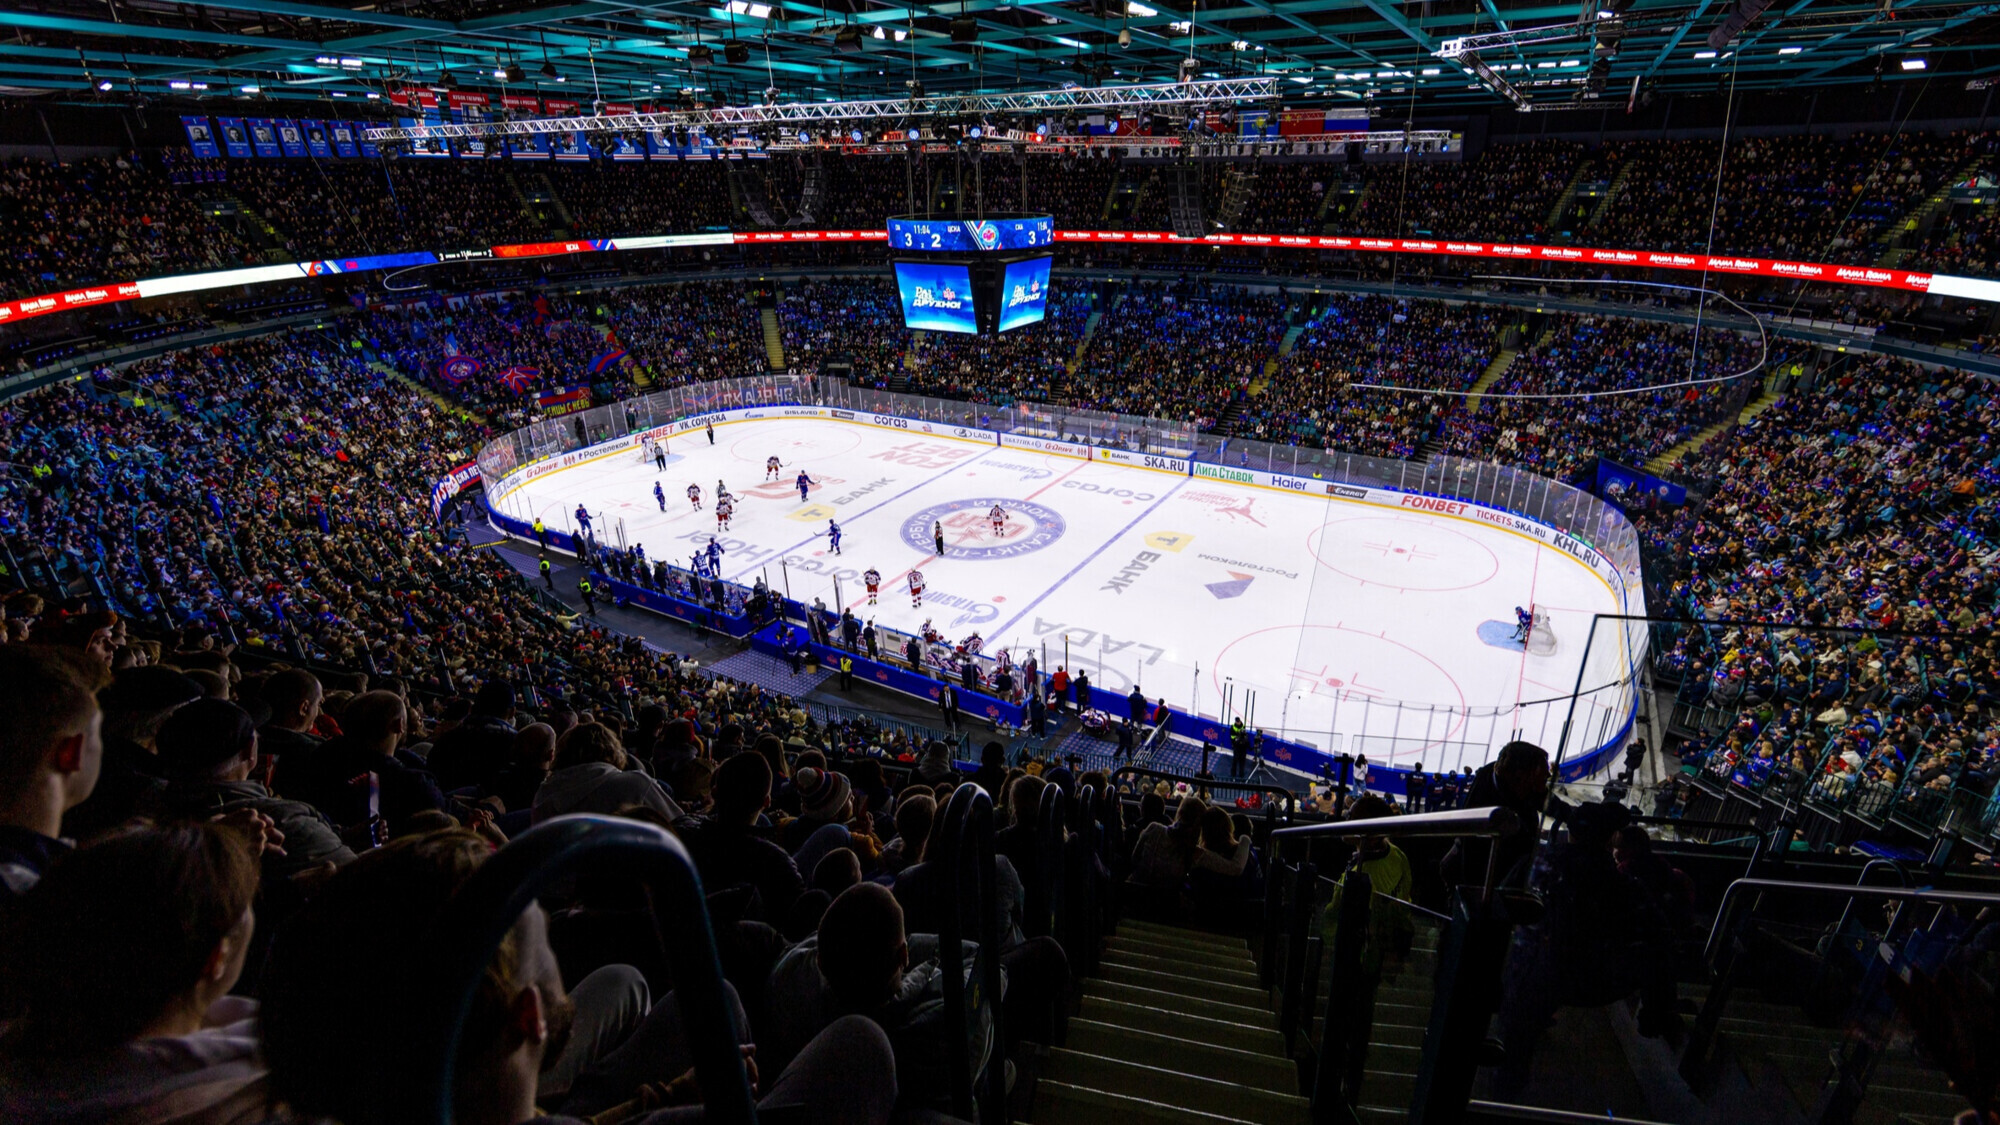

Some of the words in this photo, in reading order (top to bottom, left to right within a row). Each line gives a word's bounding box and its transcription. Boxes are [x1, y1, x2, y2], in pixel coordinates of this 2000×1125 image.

[914, 225, 931, 234] 11:04
[1047, 229, 1051, 242] 2
[905, 233, 913, 247] 3
[931, 234, 942, 248] 2
[1028, 231, 1036, 245] 3
[1650, 254, 1672, 263] MAMA
[1673, 256, 1695, 264] ROMA
[1708, 258, 1733, 267] MAMA
[1734, 260, 1758, 269] ROMA
[1772, 263, 1797, 272] MAMA
[1798, 264, 1822, 274] ROMA
[1836, 268, 1864, 278] MAMA
[1866, 270, 1892, 280] ROMA
[973, 432, 992, 440] LADA
[584, 440, 630, 458] Ростелеком
[1145, 456, 1184, 472] SKA.RU
[456, 470, 469, 484] СКА
[1272, 476, 1307, 490] Haier
[1401, 495, 1469, 515] FONBET
[1476, 509, 1546, 538] TICKETS.SKA.RU
[1553, 533, 1600, 568] KHL.RU
[1099, 550, 1162, 594] БАНК
[1198, 553, 1299, 580] Ростелеком
[1032, 617, 1165, 666] LADA
